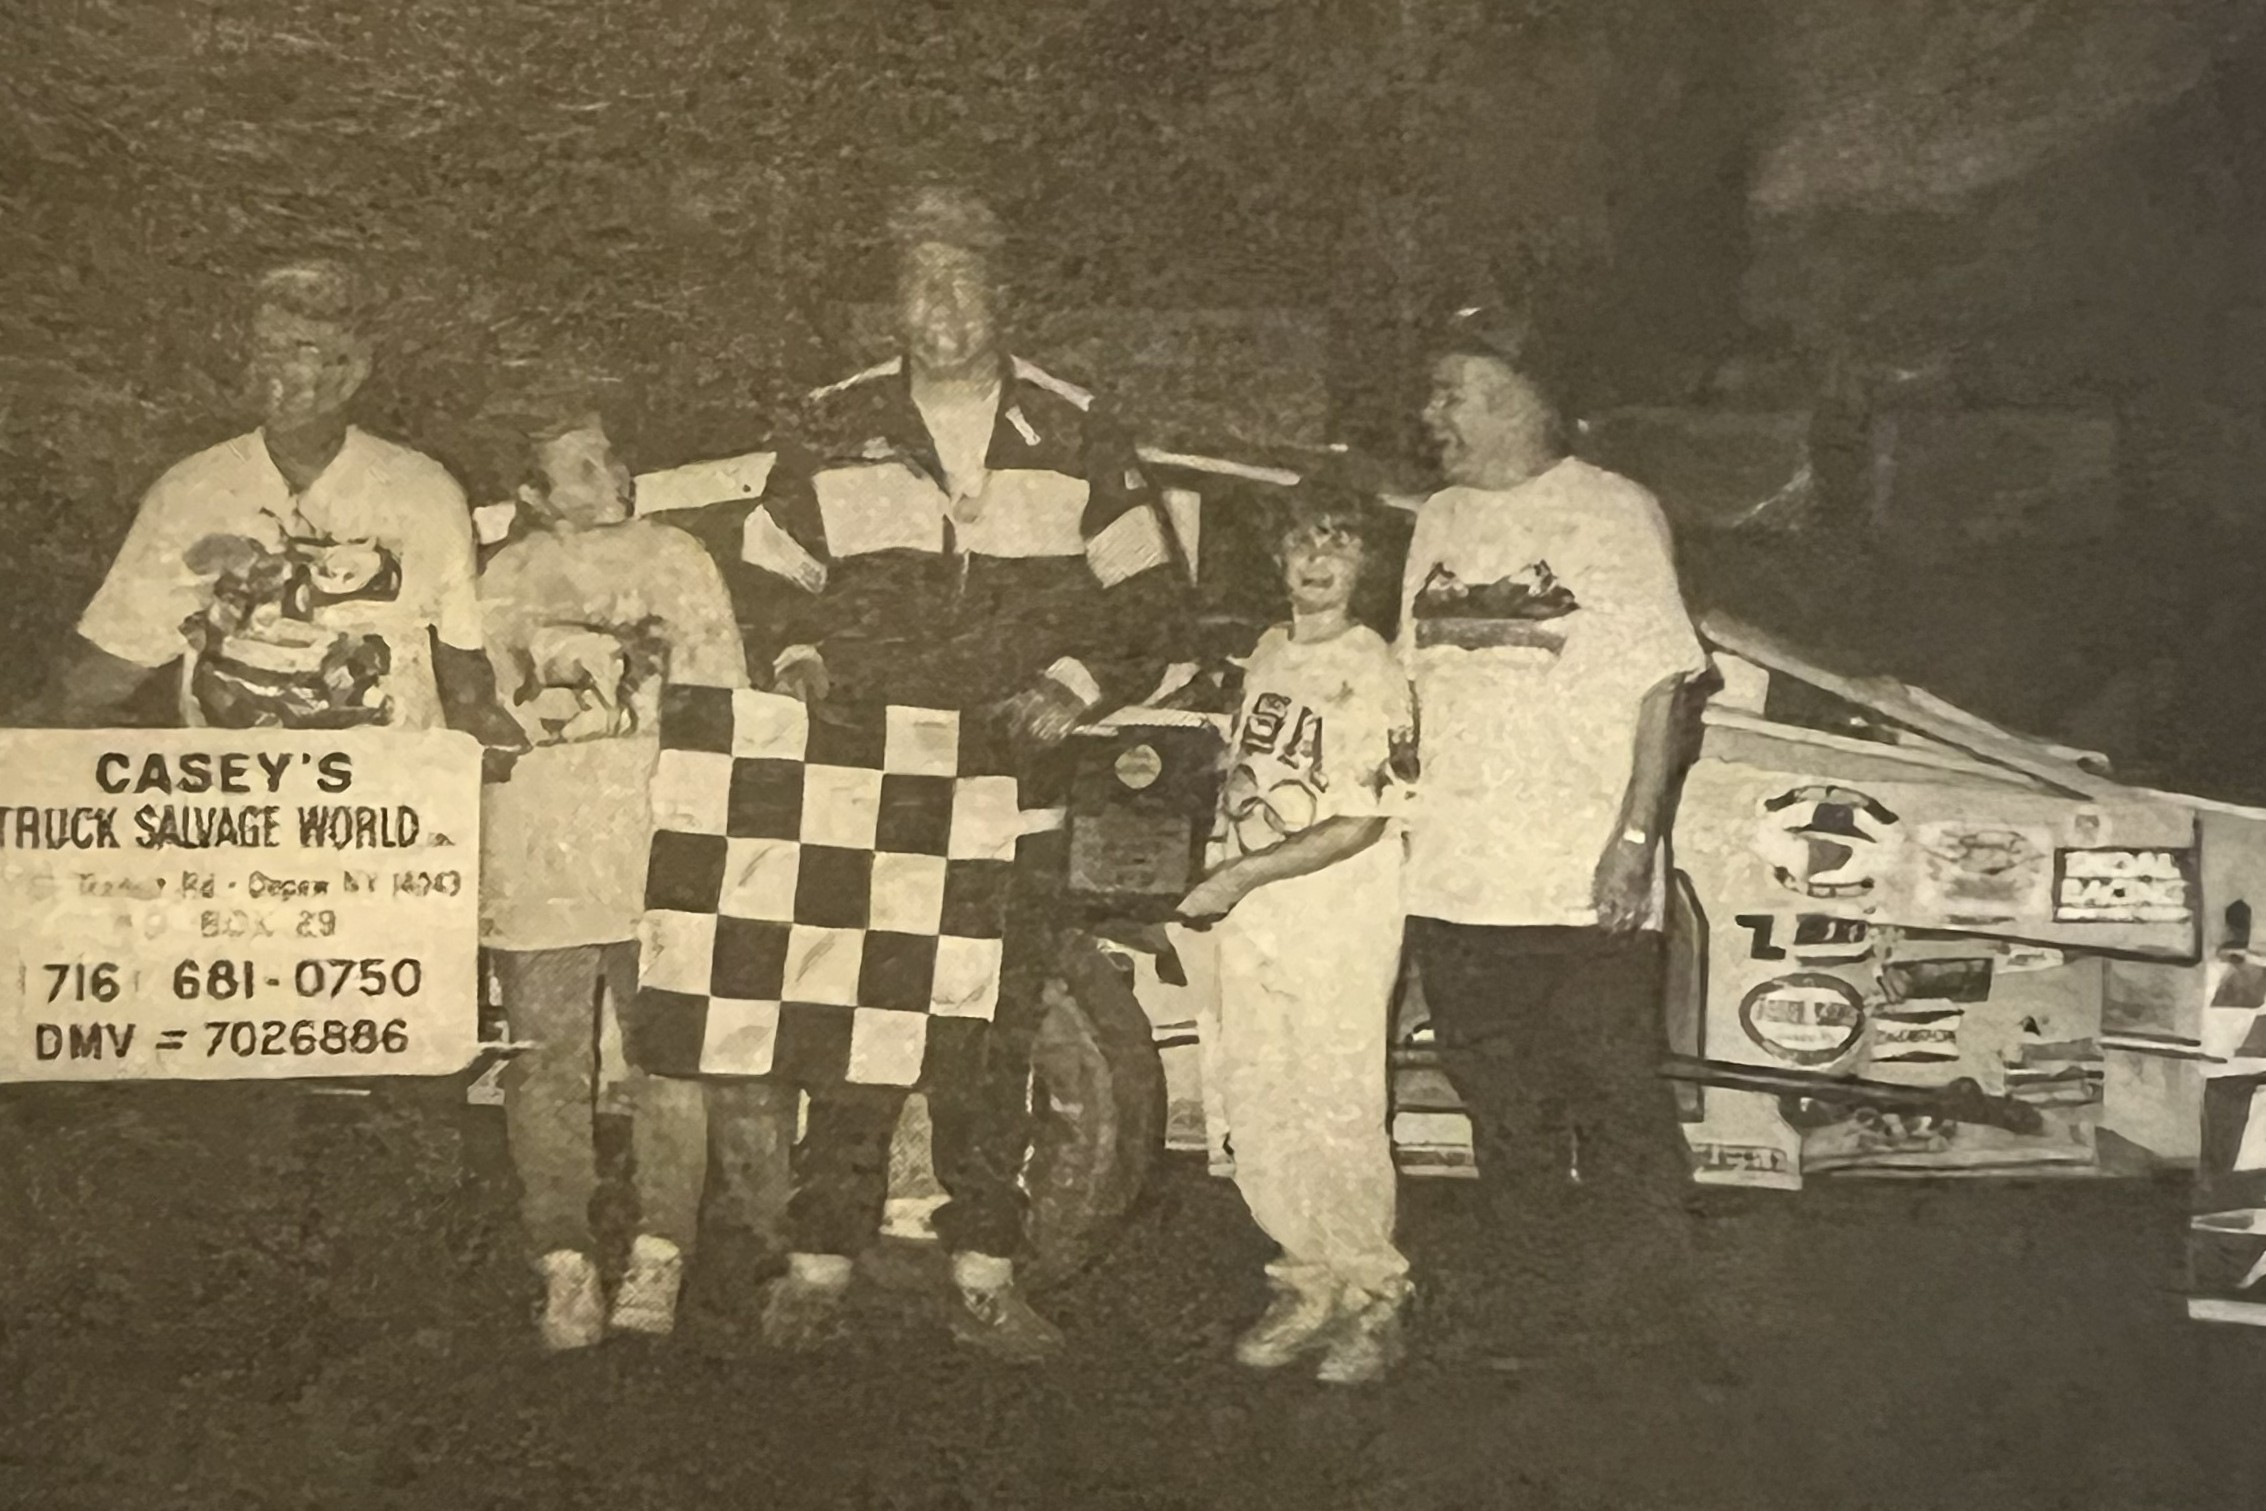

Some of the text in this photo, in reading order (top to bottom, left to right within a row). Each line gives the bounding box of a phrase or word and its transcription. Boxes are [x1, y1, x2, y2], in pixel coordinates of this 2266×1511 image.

[96, 752, 353, 793] CASEY'S
[0, 804, 420, 850] TRUCK SALVAGE WORLD
[296, 910, 336, 938] 29
[43, 963, 121, 1002] 716
[36, 1022, 136, 1060] DMV
[204, 1018, 409, 1058] 7026886
